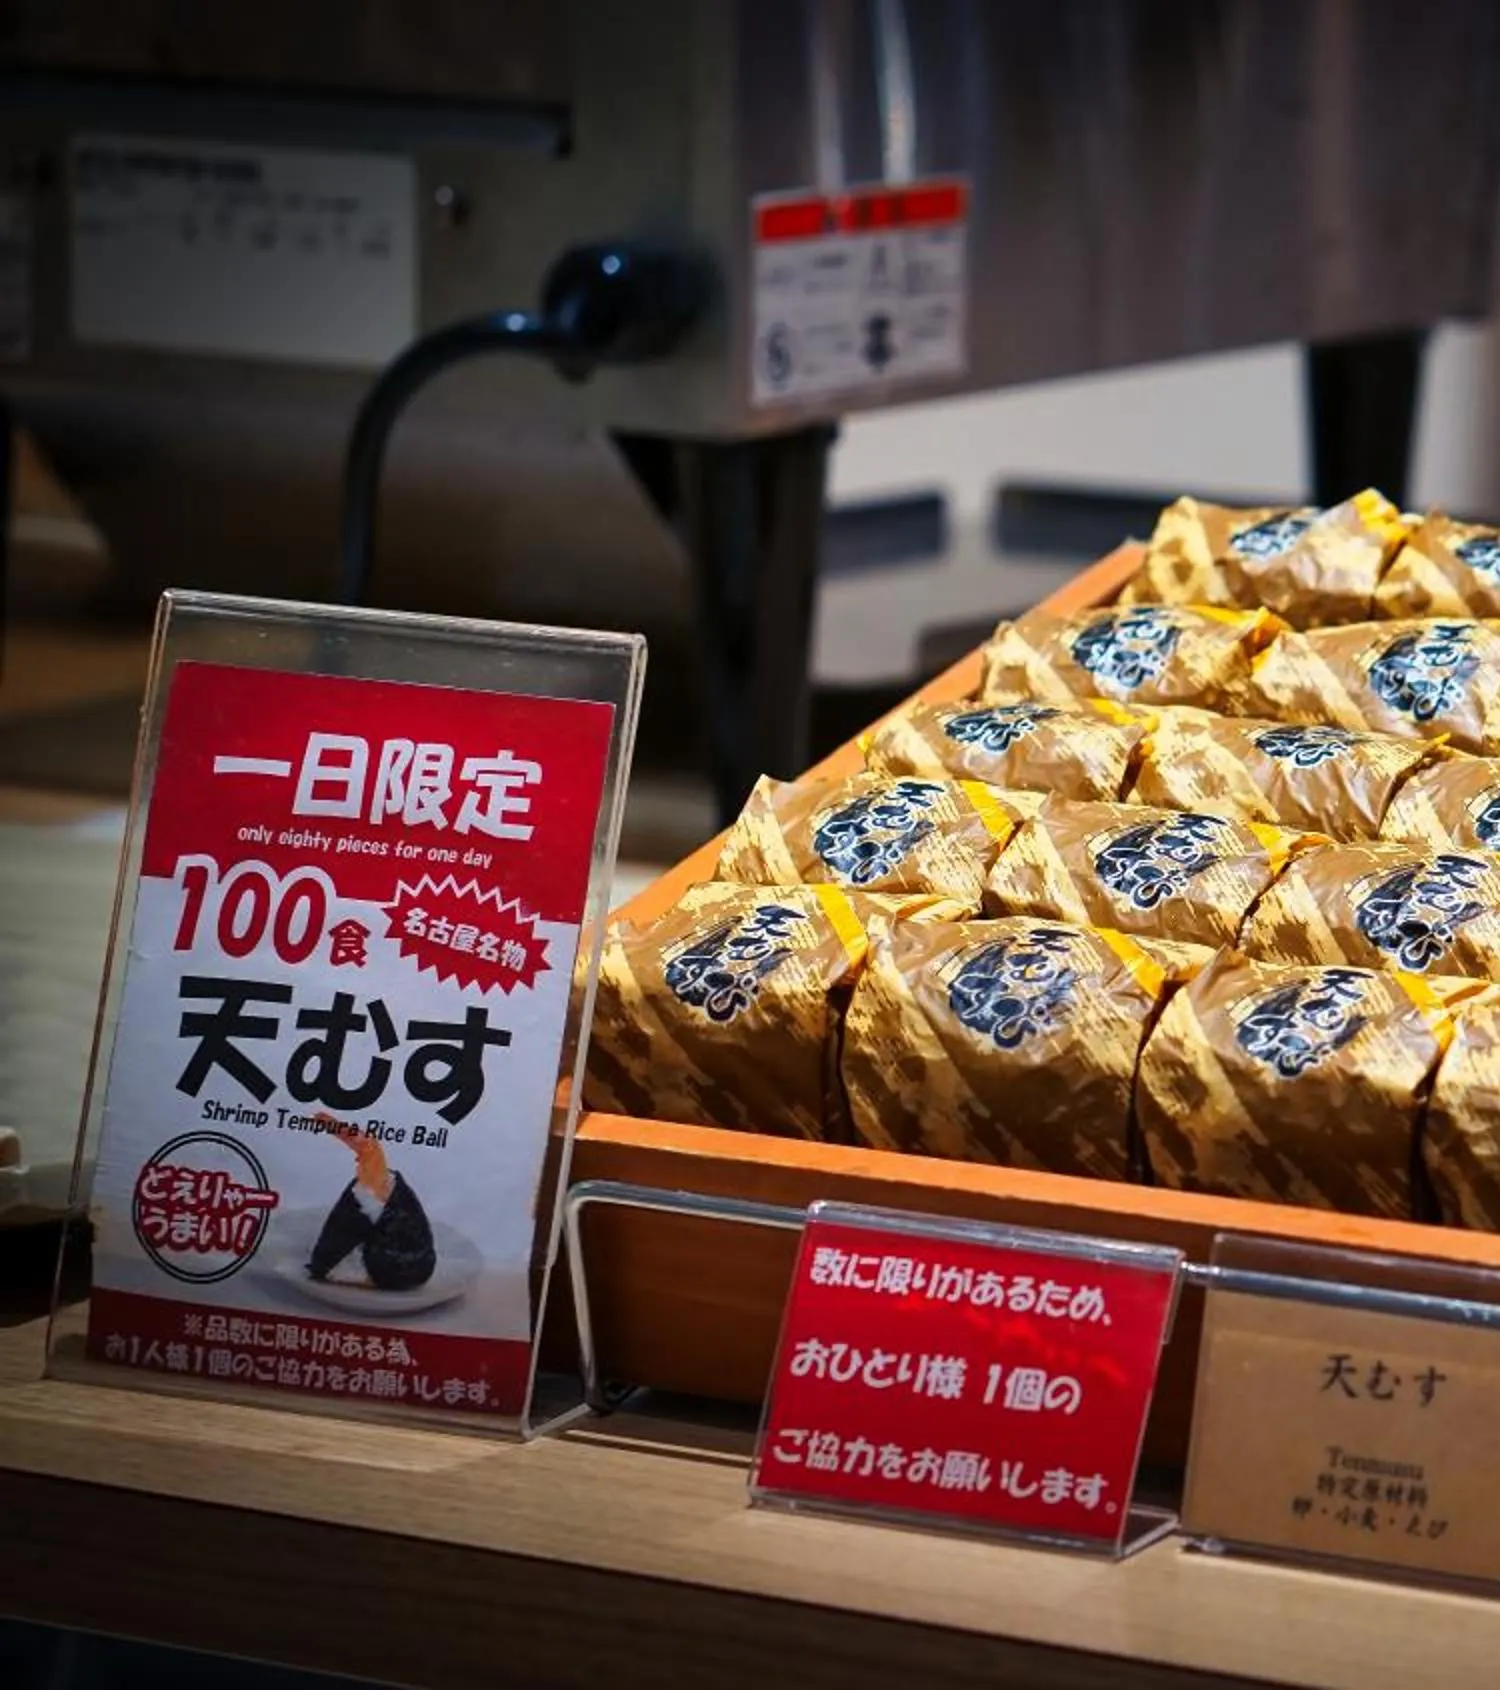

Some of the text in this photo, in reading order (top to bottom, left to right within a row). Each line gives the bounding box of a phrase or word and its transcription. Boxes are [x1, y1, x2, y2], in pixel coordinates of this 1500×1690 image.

[213, 731, 542, 843] 一日限定
[237, 824, 493, 869] only eighty pieces for one day
[403, 907, 528, 972] 名古屋名物
[175, 975, 512, 1126] 天むす
[201, 1099, 449, 1149] Shrimp Tempura Rice Ball
[809, 1247, 1113, 1326] 数に限りがあるため、
[790, 1337, 1082, 1416] おひとり様 1個の
[1320, 1353, 1447, 1408] 天むす
[772, 1427, 1118, 1515] ご協力をお願いします。
